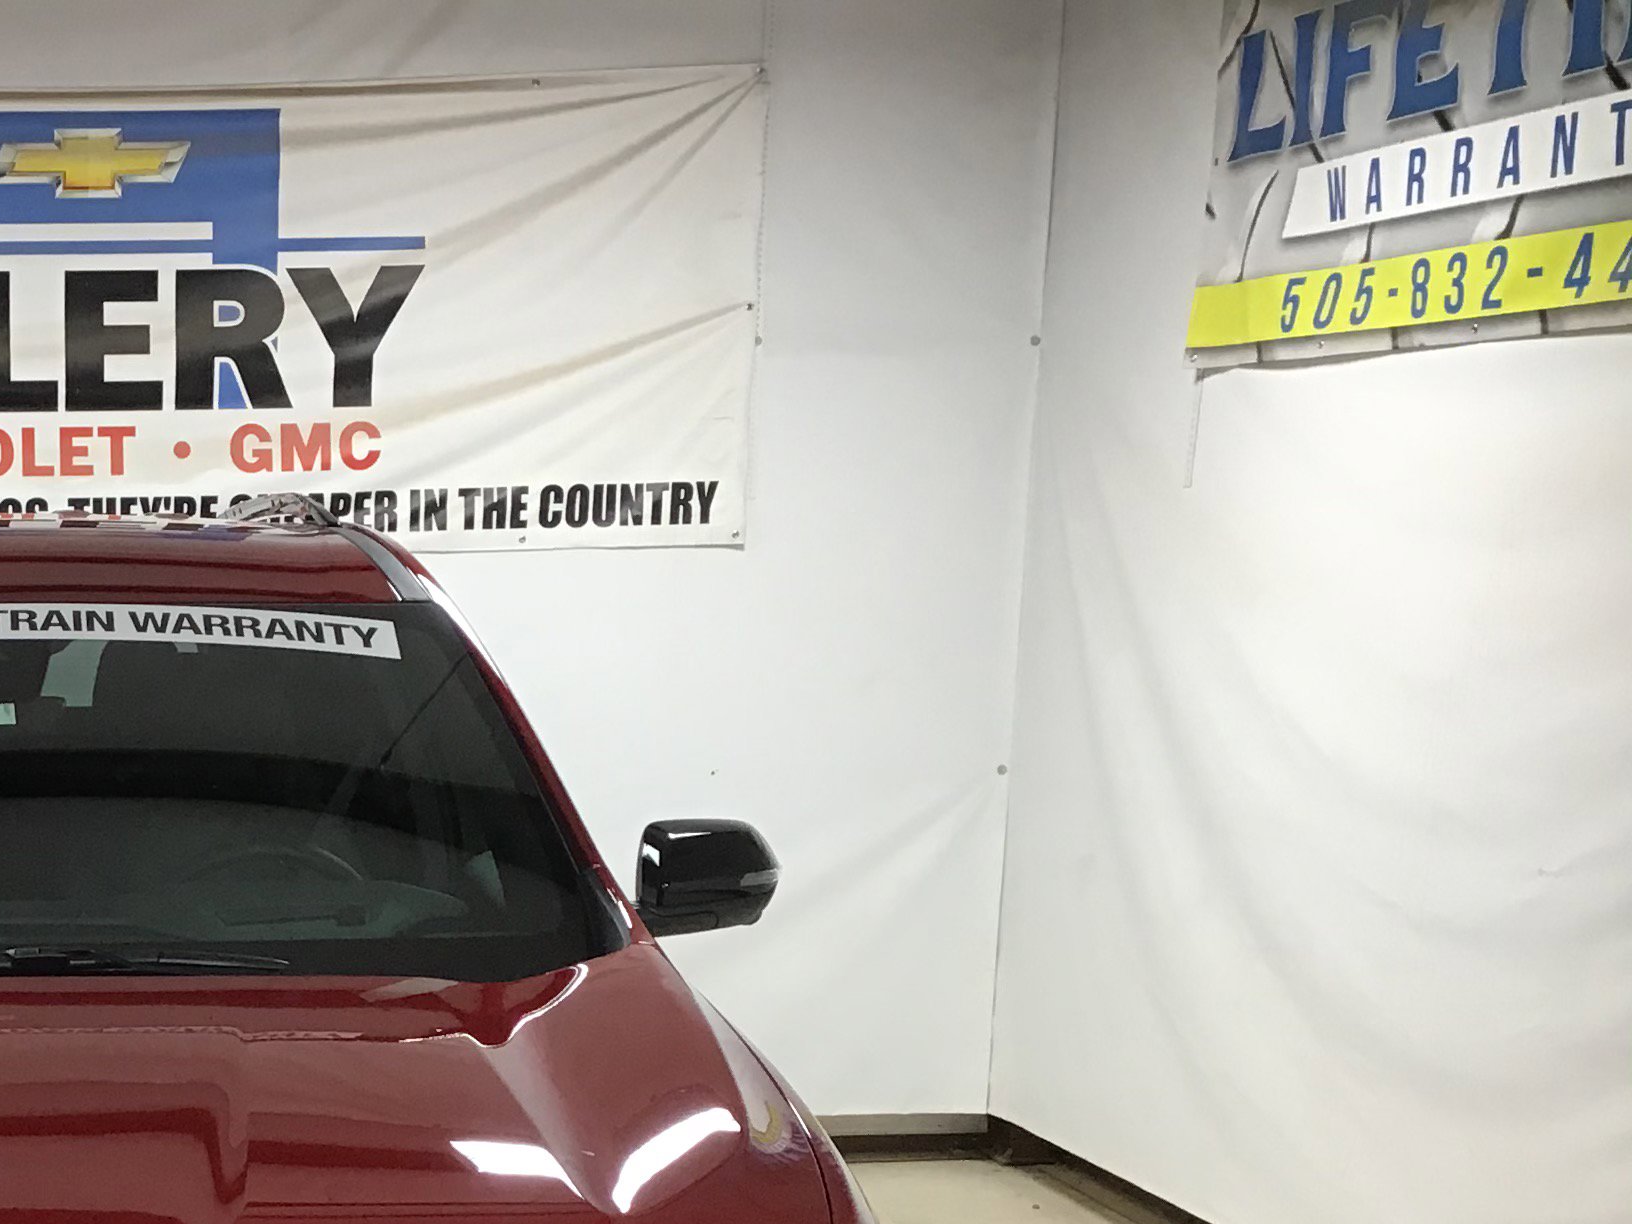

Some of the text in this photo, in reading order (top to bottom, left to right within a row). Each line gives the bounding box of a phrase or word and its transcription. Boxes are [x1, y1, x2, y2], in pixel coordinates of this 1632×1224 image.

[1227, 0, 1632, 162] LIFETI
[1280, 232, 1632, 333] 505-832-44
[230, 421, 381, 474] GMC
[409, 488, 450, 532] IN
[459, 486, 530, 531] THE
[539, 481, 719, 530] COUNTRY
[128, 611, 379, 649] WARRANTY
